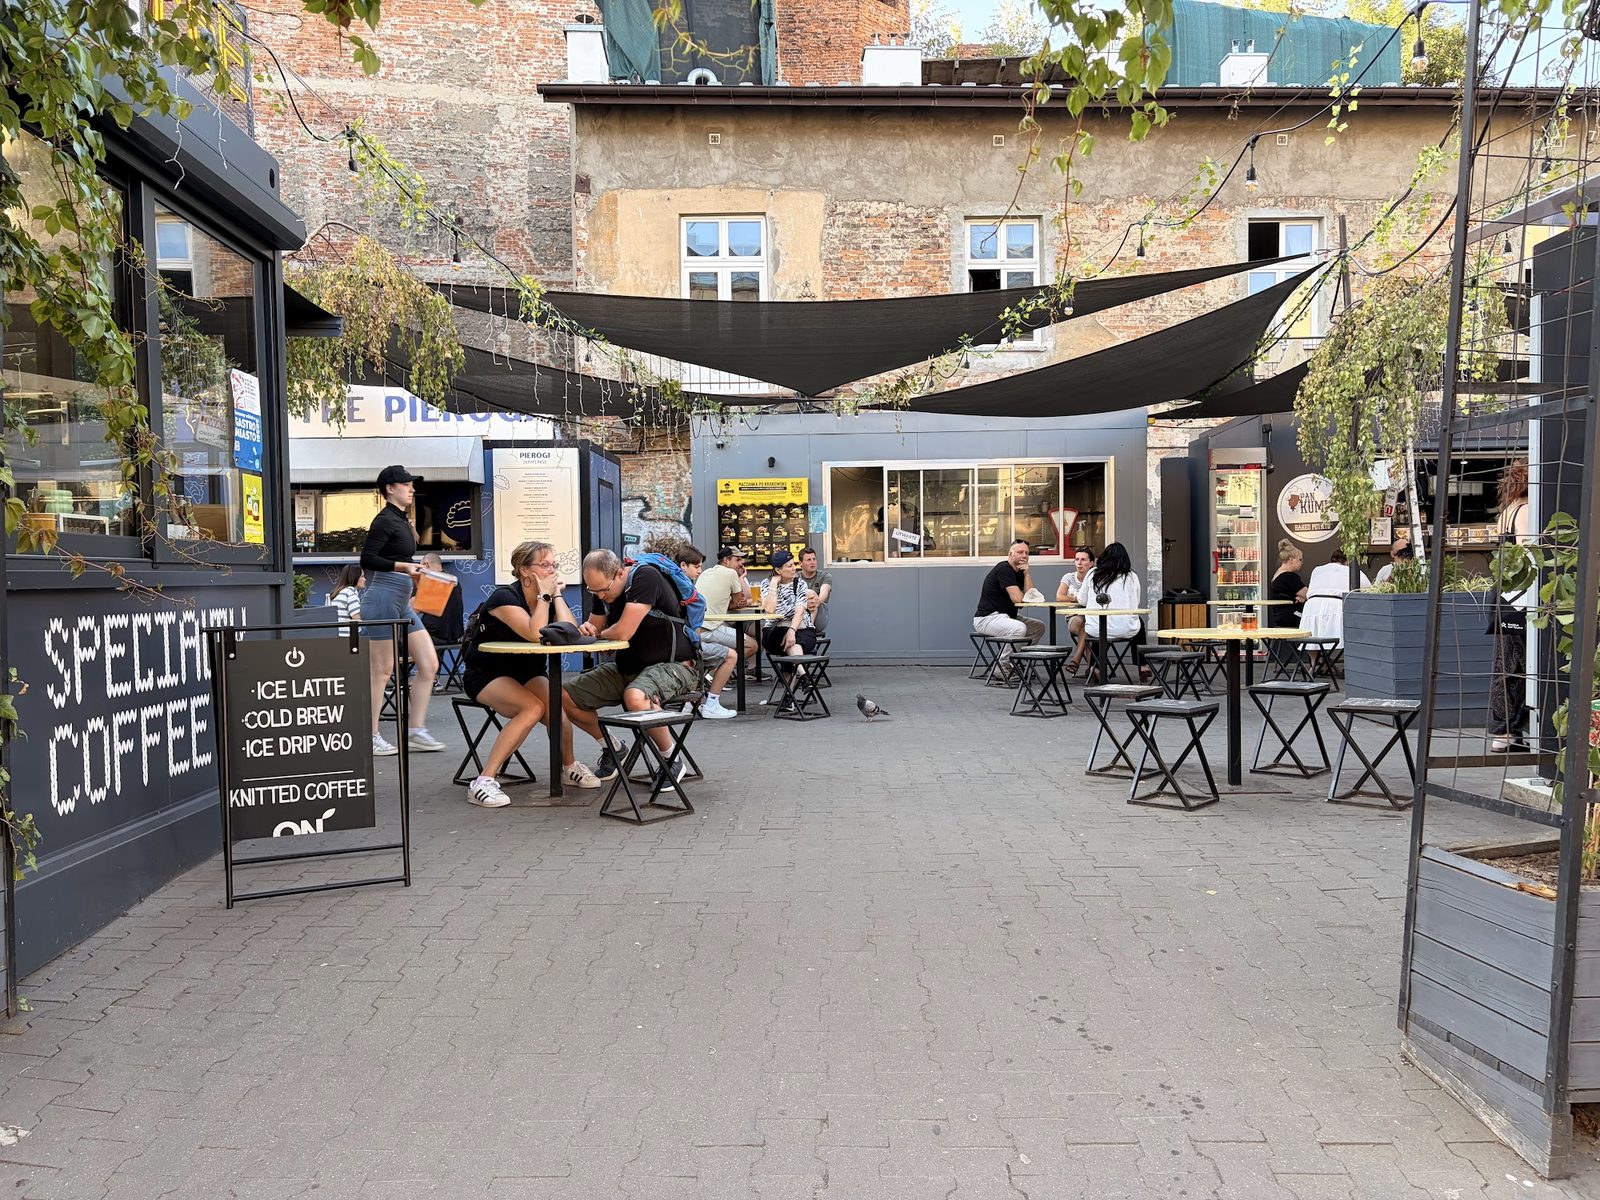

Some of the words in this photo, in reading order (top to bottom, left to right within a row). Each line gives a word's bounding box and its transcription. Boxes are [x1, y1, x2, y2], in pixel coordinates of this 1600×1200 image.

[1300, 500, 1326, 514] KUM
[257, 680, 288, 700] ICE
[292, 677, 346, 698] LATTE
[244, 709, 293, 729] COLD
[296, 705, 345, 726] BREW
[50, 693, 212, 817] COFFEE
[246, 738, 275, 758] ICE
[279, 735, 318, 756] DRIP
[320, 732, 353, 751] V60
[230, 784, 301, 808] KNITTED
[304, 778, 367, 801] COFFEE
